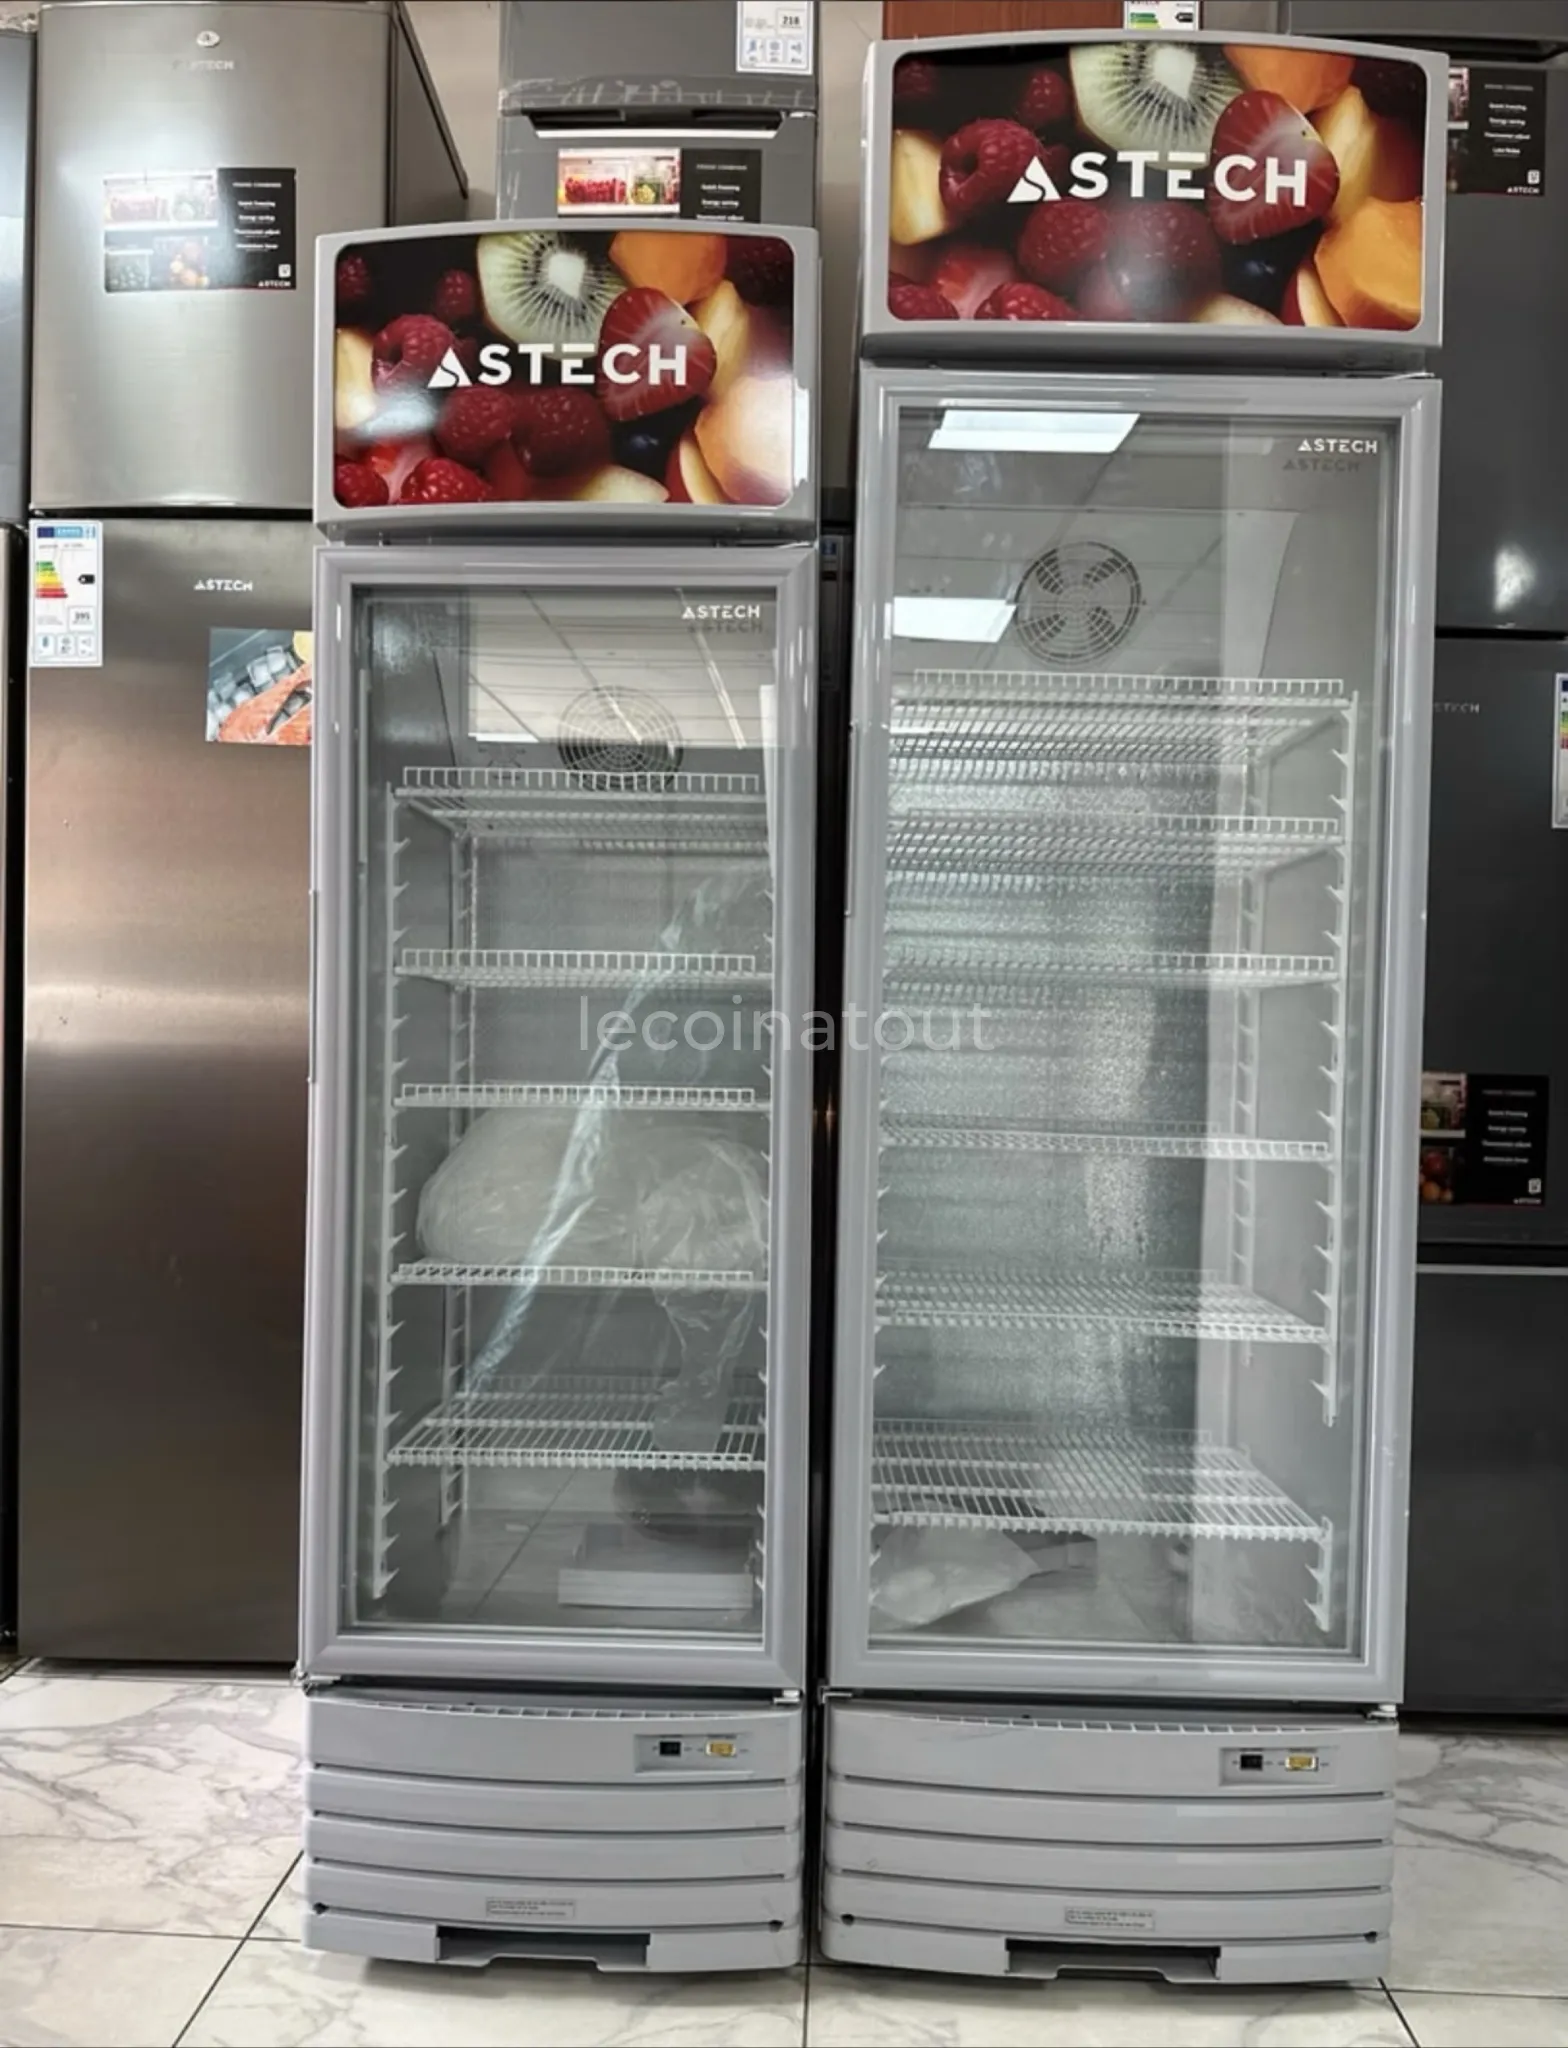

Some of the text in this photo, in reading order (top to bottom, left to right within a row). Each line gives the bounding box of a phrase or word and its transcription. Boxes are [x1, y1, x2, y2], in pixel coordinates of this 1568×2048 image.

[1007, 150, 1308, 207] ASTECH
[427, 344, 687, 388] ASTECH
[1298, 438, 1378, 453] ASTECH
[192, 578, 253, 591] ASTECH
[682, 604, 760, 619] ASTECH
